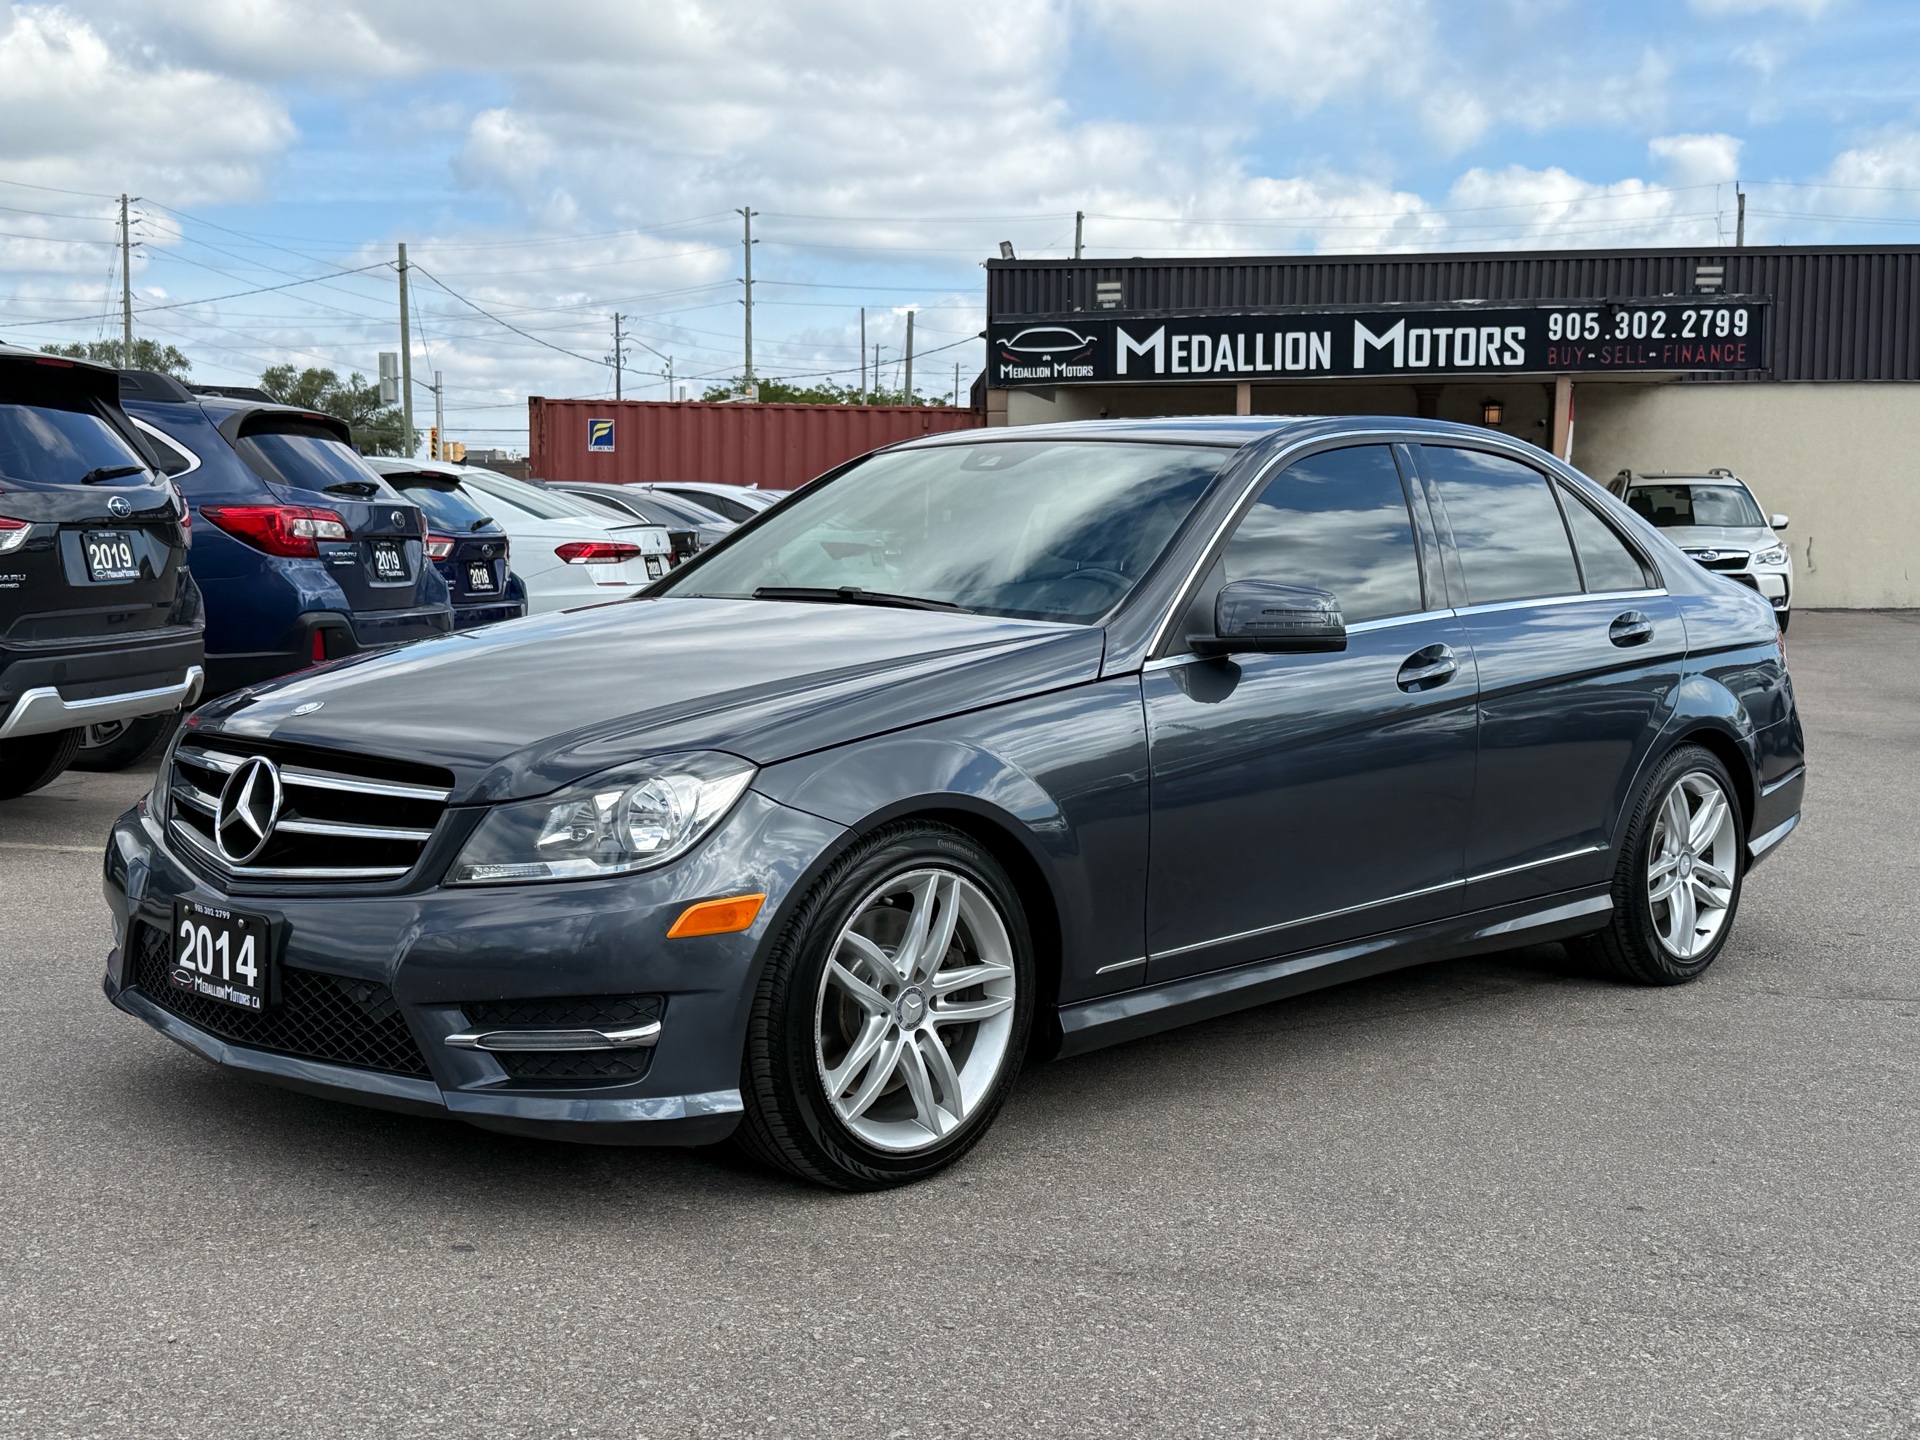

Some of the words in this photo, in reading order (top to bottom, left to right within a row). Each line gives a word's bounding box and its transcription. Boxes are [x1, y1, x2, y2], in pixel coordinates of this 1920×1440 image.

[1548, 309, 1748, 341] 905.302.2799
[1116, 325, 1332, 375] MEDALLION
[1353, 318, 1526, 369] MOTORS
[1548, 347, 1585, 365] BUY
[1600, 346, 1647, 364] SELL
[1663, 343, 1747, 364] FINANCE
[1000, 364, 1050, 379] MEDALLION
[1053, 362, 1094, 378] MOTORS
[90, 543, 132, 569] 2019
[375, 551, 400, 569] 2019
[470, 568, 490, 584] 2018
[937, 839, 974, 858] Continental
[203, 906, 215, 917] 302
[215, 909, 230, 919] 2799
[179, 919, 258, 988] 2014
